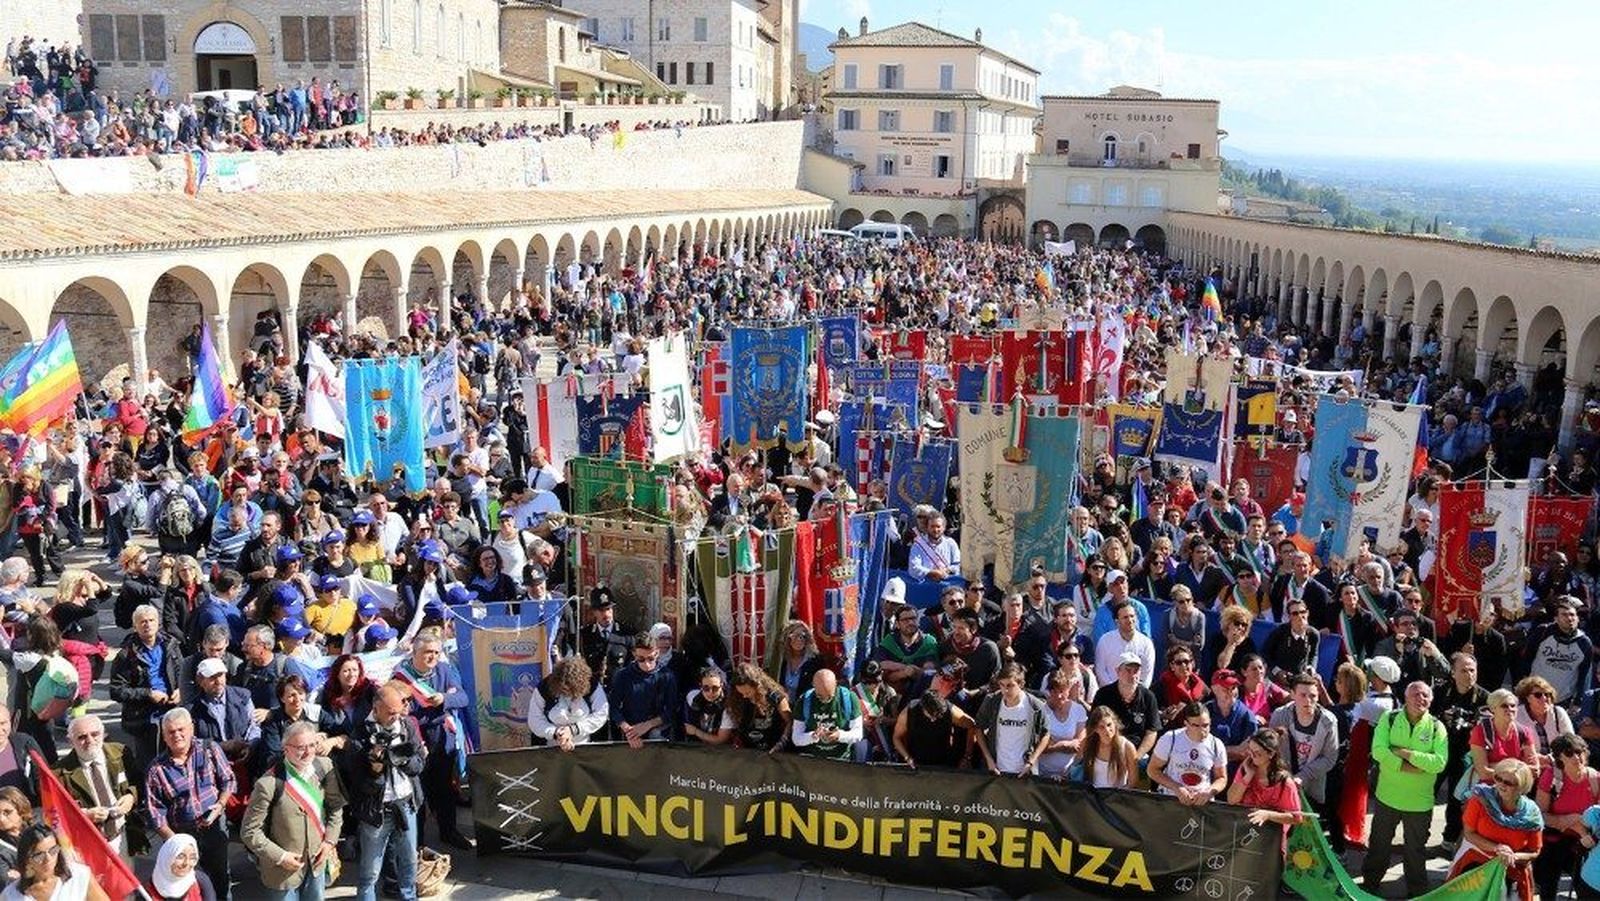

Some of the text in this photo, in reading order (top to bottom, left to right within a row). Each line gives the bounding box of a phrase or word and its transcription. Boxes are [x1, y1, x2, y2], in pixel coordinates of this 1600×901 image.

[1085, 113, 1173, 122] HOTEL SUBASIO
[964, 426, 1008, 455] COMUNE
[669, 774, 706, 790] Marcia
[709, 779, 776, 799] PerugiAssisi
[779, 783, 806, 798] della
[809, 791, 837, 803] pace
[840, 797, 849, 806] e
[850, 796, 881, 809] della
[884, 797, 942, 811] fraternità
[953, 805, 961, 814] 9
[964, 803, 1010, 818] ottobre
[1014, 810, 1042, 823] 2016
[560, 795, 1155, 892] VINCI L'INDIFFERENZA
